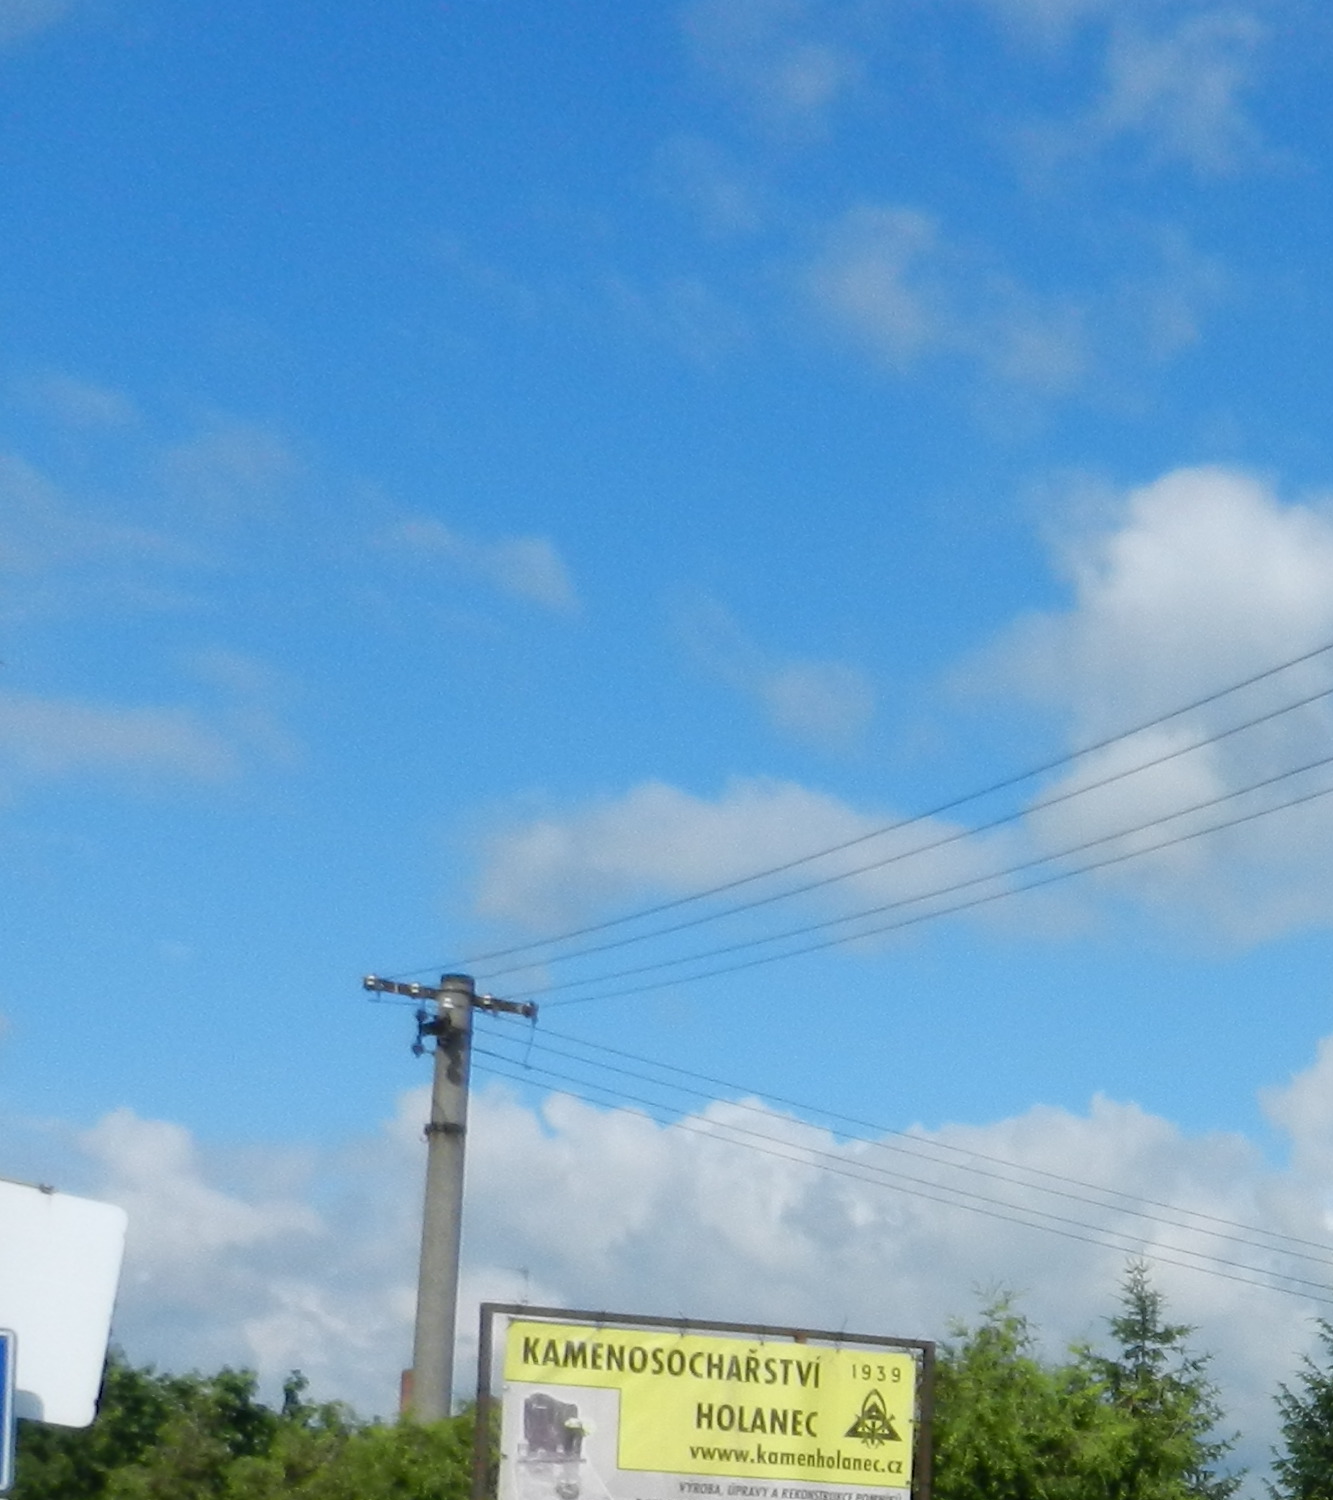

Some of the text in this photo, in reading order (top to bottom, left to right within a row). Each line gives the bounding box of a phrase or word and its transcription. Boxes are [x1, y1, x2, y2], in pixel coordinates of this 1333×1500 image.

[523, 1336, 821, 1388] KAMENOSOCHAŘSTVÍ
[852, 1363, 902, 1383] 1939
[696, 1402, 818, 1438] HOLANEC
[690, 1444, 903, 1474] www.kamenholanec.cz
